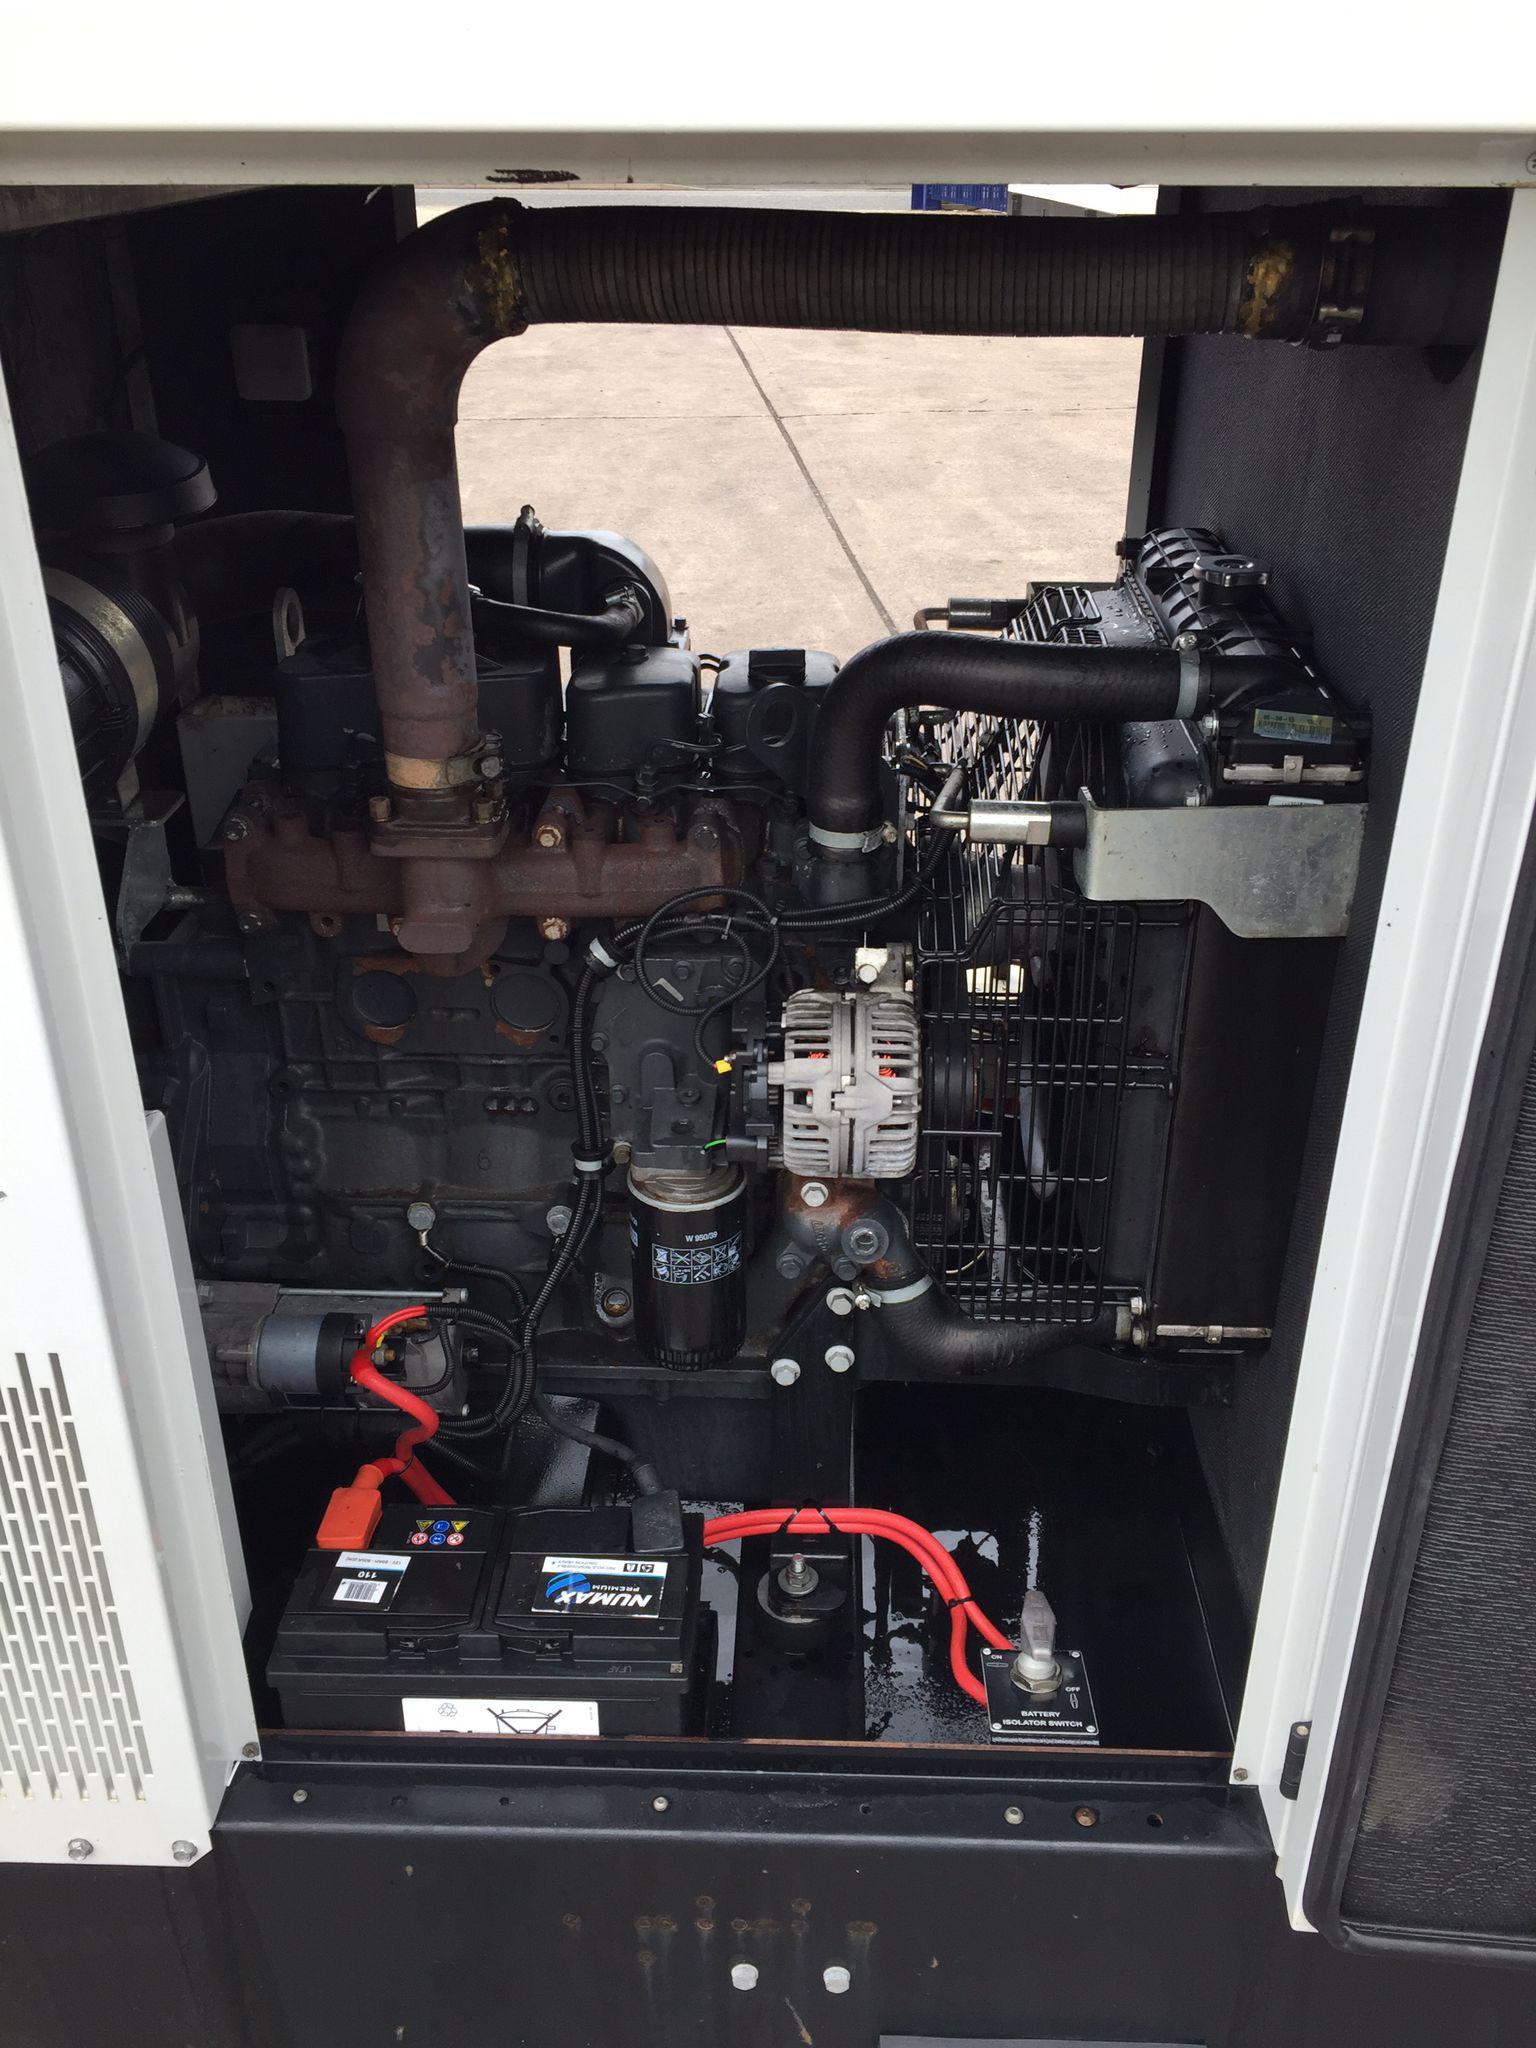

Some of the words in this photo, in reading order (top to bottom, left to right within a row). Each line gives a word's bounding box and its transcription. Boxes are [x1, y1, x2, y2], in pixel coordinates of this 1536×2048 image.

[685, 1234, 693, 1243] W
[358, 1570, 377, 1578] 110
[554, 1590, 653, 1607] NUMAX
